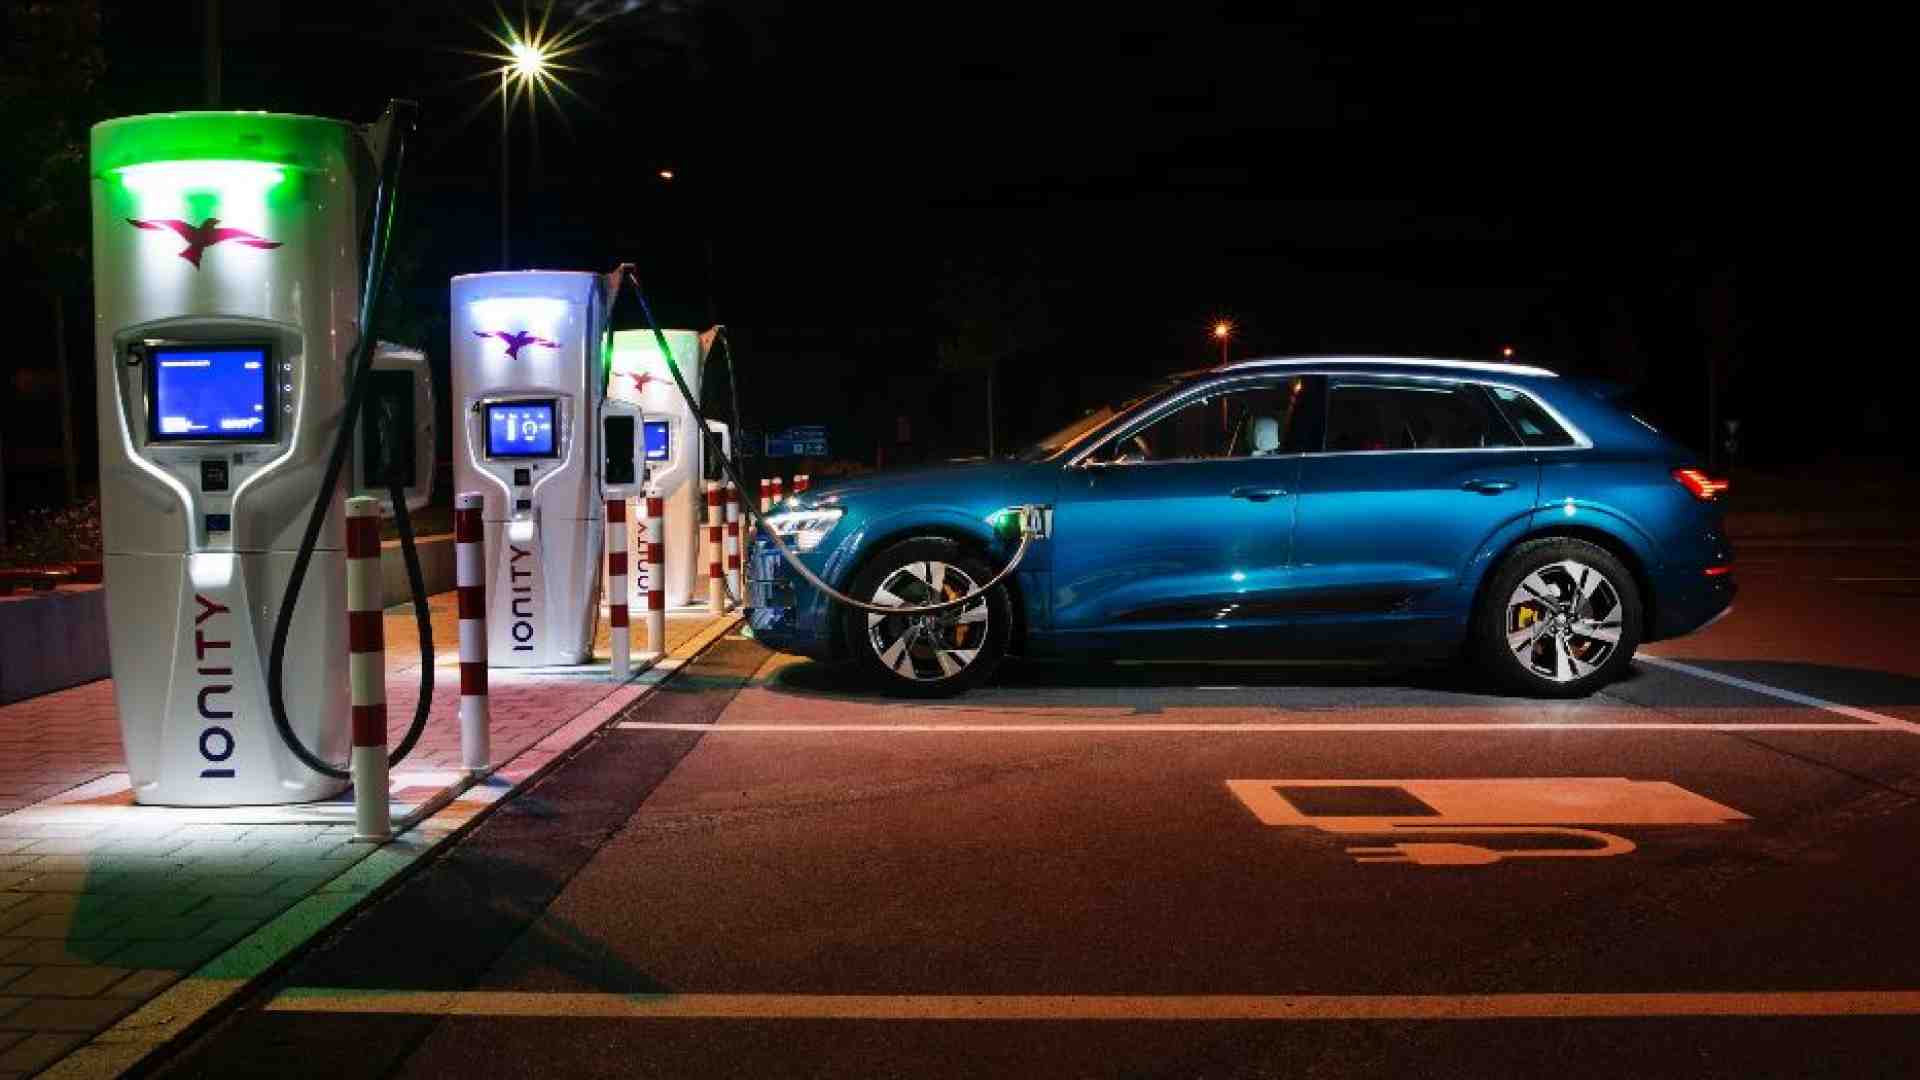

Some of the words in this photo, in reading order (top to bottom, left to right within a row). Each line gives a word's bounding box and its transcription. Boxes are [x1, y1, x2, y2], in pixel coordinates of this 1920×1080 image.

[127, 343, 143, 367] 5
[510, 544, 534, 651] IONITY
[195, 593, 235, 778] IONITY
